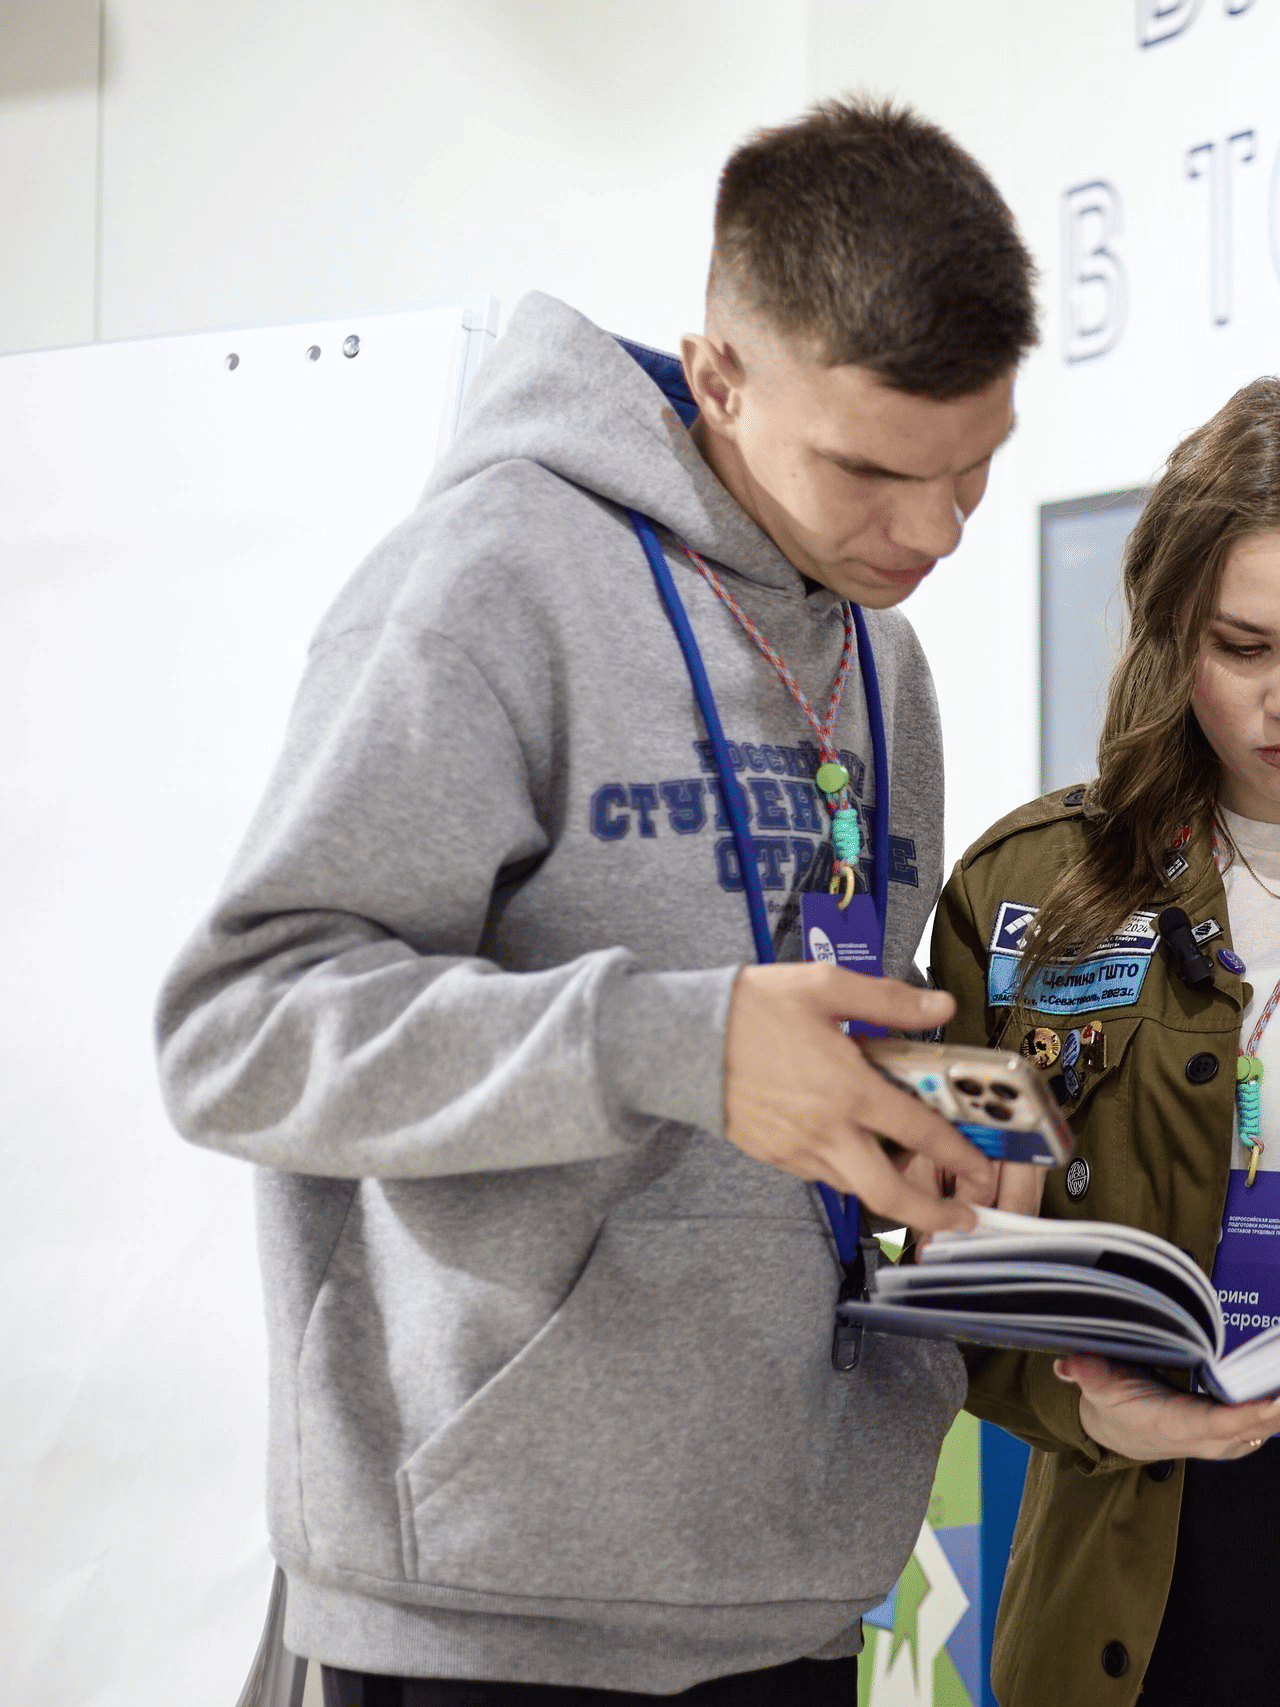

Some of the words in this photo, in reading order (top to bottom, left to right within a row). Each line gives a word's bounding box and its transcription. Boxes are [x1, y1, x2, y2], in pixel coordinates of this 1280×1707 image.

[1124, 923, 1149, 934] 2024
[1042, 970, 1096, 989] Целина
[1229, 1215, 1268, 1223] ВСЕРОССИЙСКАЯ
[1228, 1221, 1258, 1229] ПОДГОТОВКИ
[1217, 1289, 1259, 1306] рина
